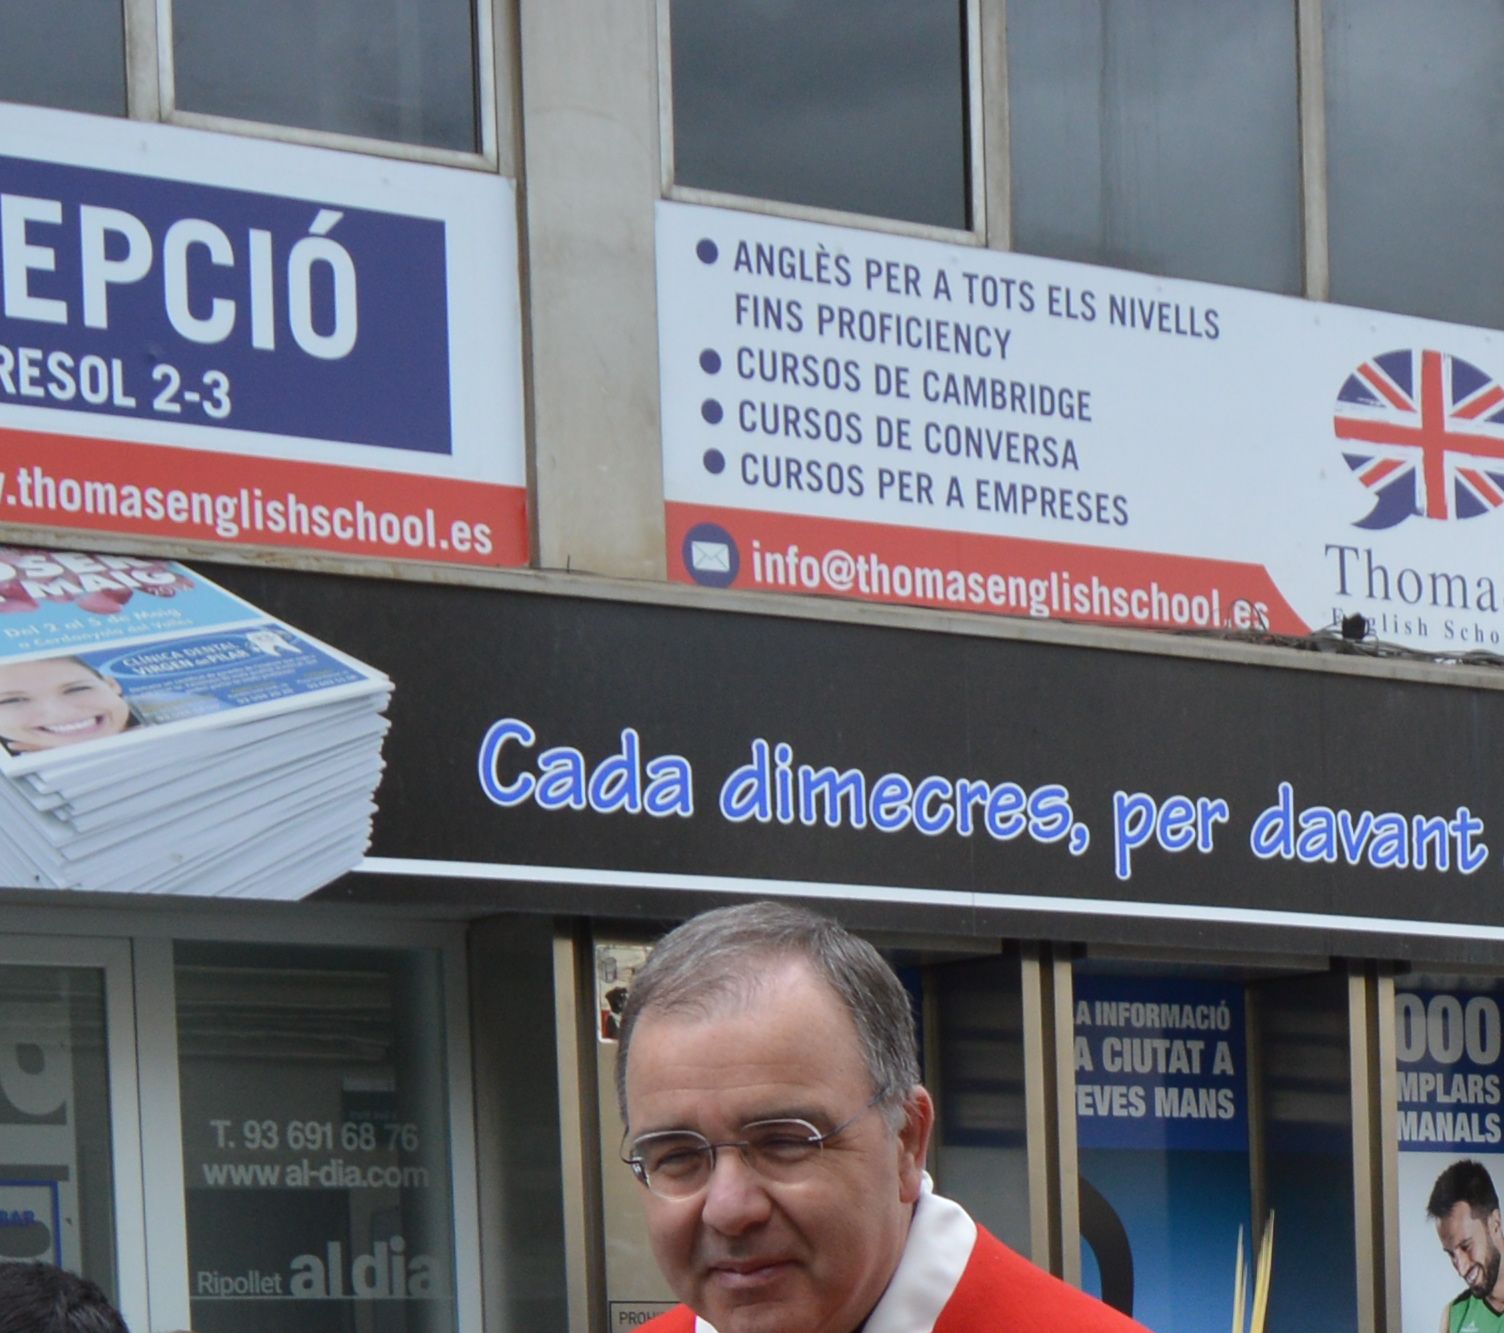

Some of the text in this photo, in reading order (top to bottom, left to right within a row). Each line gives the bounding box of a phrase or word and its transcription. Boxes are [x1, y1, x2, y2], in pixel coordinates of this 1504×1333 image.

[733, 240, 1221, 341] ANGLÈS PER A TOTS ELS NIVELLS
[735, 292, 1012, 361] FINS PROFICIENCY
[151, 362, 233, 420] 2-3
[736, 346, 1093, 423] CURSOS DE CAMBRIDGE
[738, 399, 1081, 472] CURSOS DE CONVERSA
[741, 452, 1130, 527] CURSOS PER A EMPRESES
[21, 566, 178, 601] MAIG
[751, 540, 1270, 633] info@thomasenglishschool.es
[1331, 606, 1429, 638] Eglish
[477, 718, 695, 818] Cada
[718, 737, 1091, 857] dimecres,
[1112, 790, 1230, 881] per
[1249, 781, 1490, 874] davant
[1096, 999, 1232, 1031] INFORMACIÓ
[1102, 1036, 1206, 1075] CIUTAT
[1212, 1040, 1235, 1076] A
[1153, 1086, 1236, 1120] MANS
[243, 1119, 280, 1150] 93
[286, 1121, 333, 1151] 691
[341, 1122, 377, 1151] 68
[383, 1123, 420, 1151] 76
[196, 1270, 284, 1297] Ripollet
